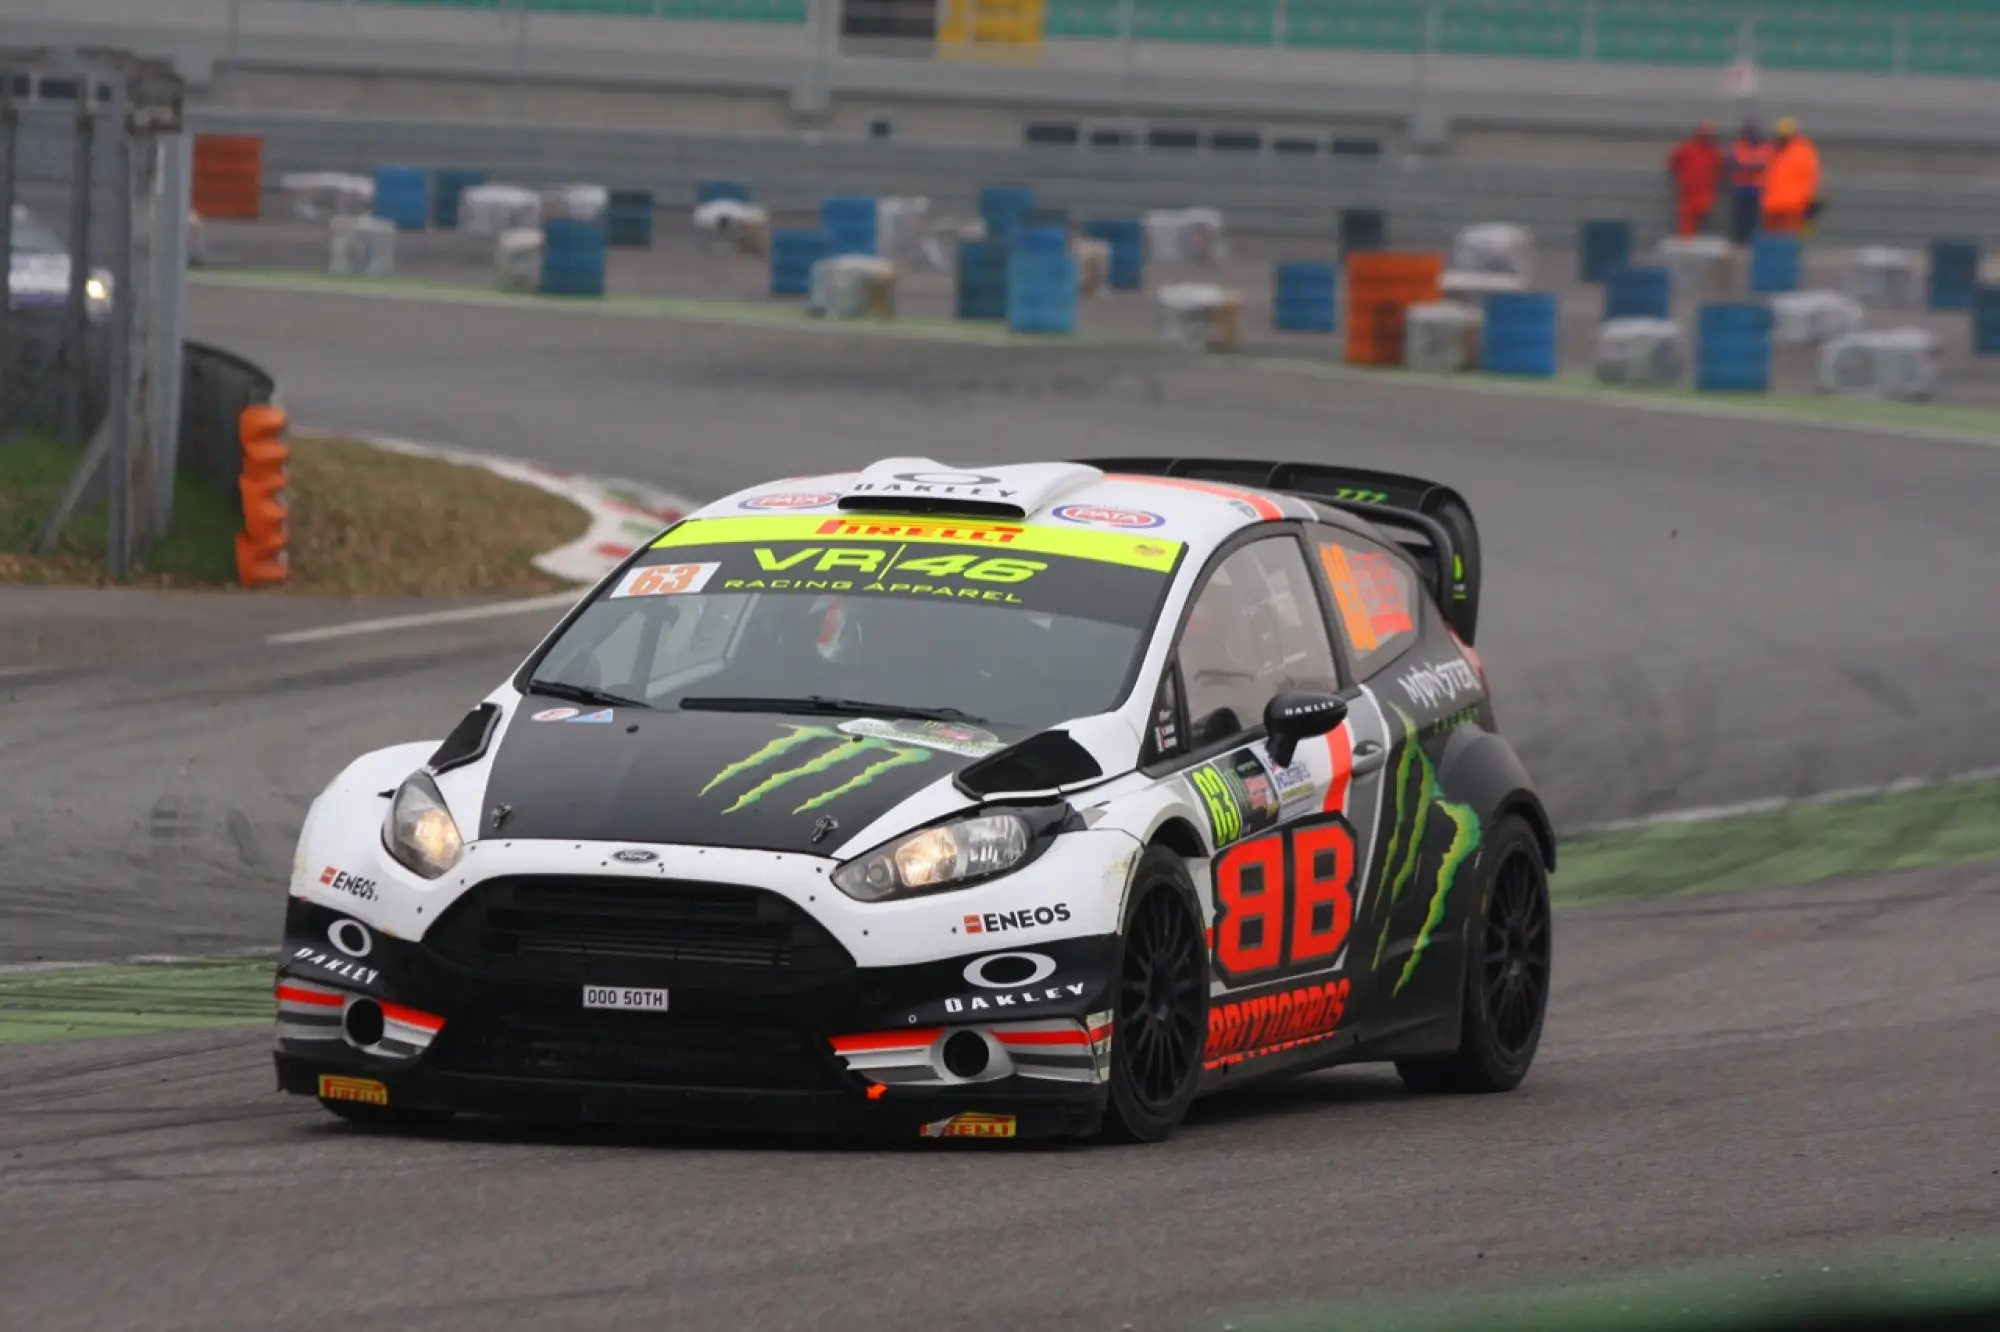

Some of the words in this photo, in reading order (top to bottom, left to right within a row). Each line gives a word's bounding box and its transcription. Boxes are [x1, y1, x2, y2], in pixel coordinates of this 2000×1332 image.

[853, 483, 1018, 498] OAKLEY
[815, 519, 1024, 543] PIRELLI
[628, 562, 701, 597] 63
[723, 578, 853, 591] RACING
[863, 579, 1023, 604] APPAREL
[332, 870, 377, 901] ENEOS
[982, 902, 1071, 933] ENEOS
[293, 946, 380, 985] OAKLEY
[944, 981, 1084, 1013] OAKLEY
